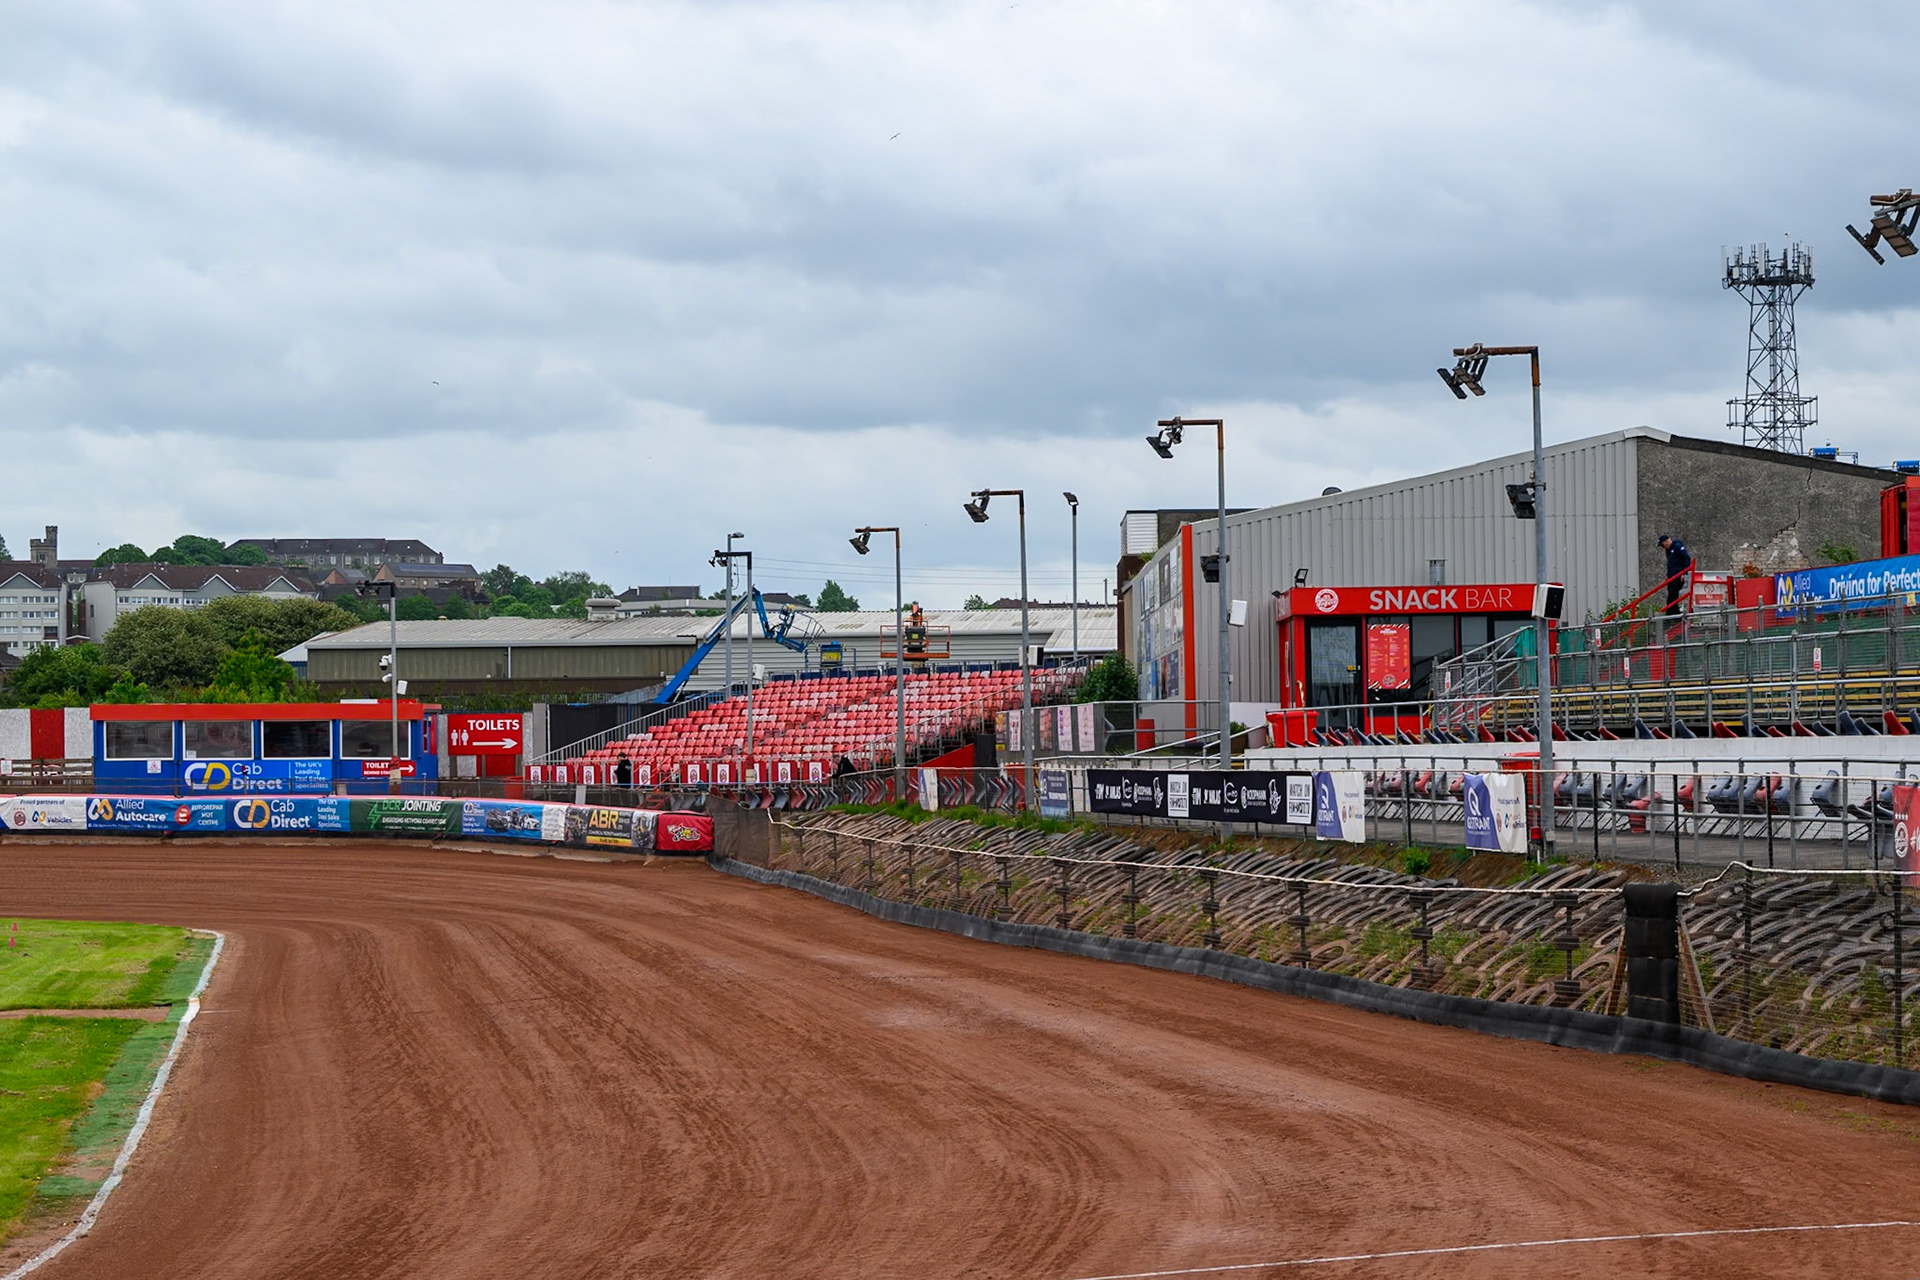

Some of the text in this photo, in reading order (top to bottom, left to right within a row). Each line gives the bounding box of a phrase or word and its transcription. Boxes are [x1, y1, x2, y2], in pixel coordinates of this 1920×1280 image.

[1794, 573, 1811, 591] Allied
[1829, 573, 1864, 599] Driving
[1867, 571, 1881, 594] for
[1369, 588, 1513, 610] SNACK BAR
[467, 719, 520, 731] TOILETS
[232, 762, 262, 775] Cab
[232, 778, 283, 790] Direct
[115, 799, 144, 809] Allied
[271, 800, 295, 812] Cab
[382, 800, 441, 811] DCR JOINTING
[115, 812, 166, 822] Autocare
[271, 815, 310, 828] Direct
[589, 810, 619, 829] ABR
